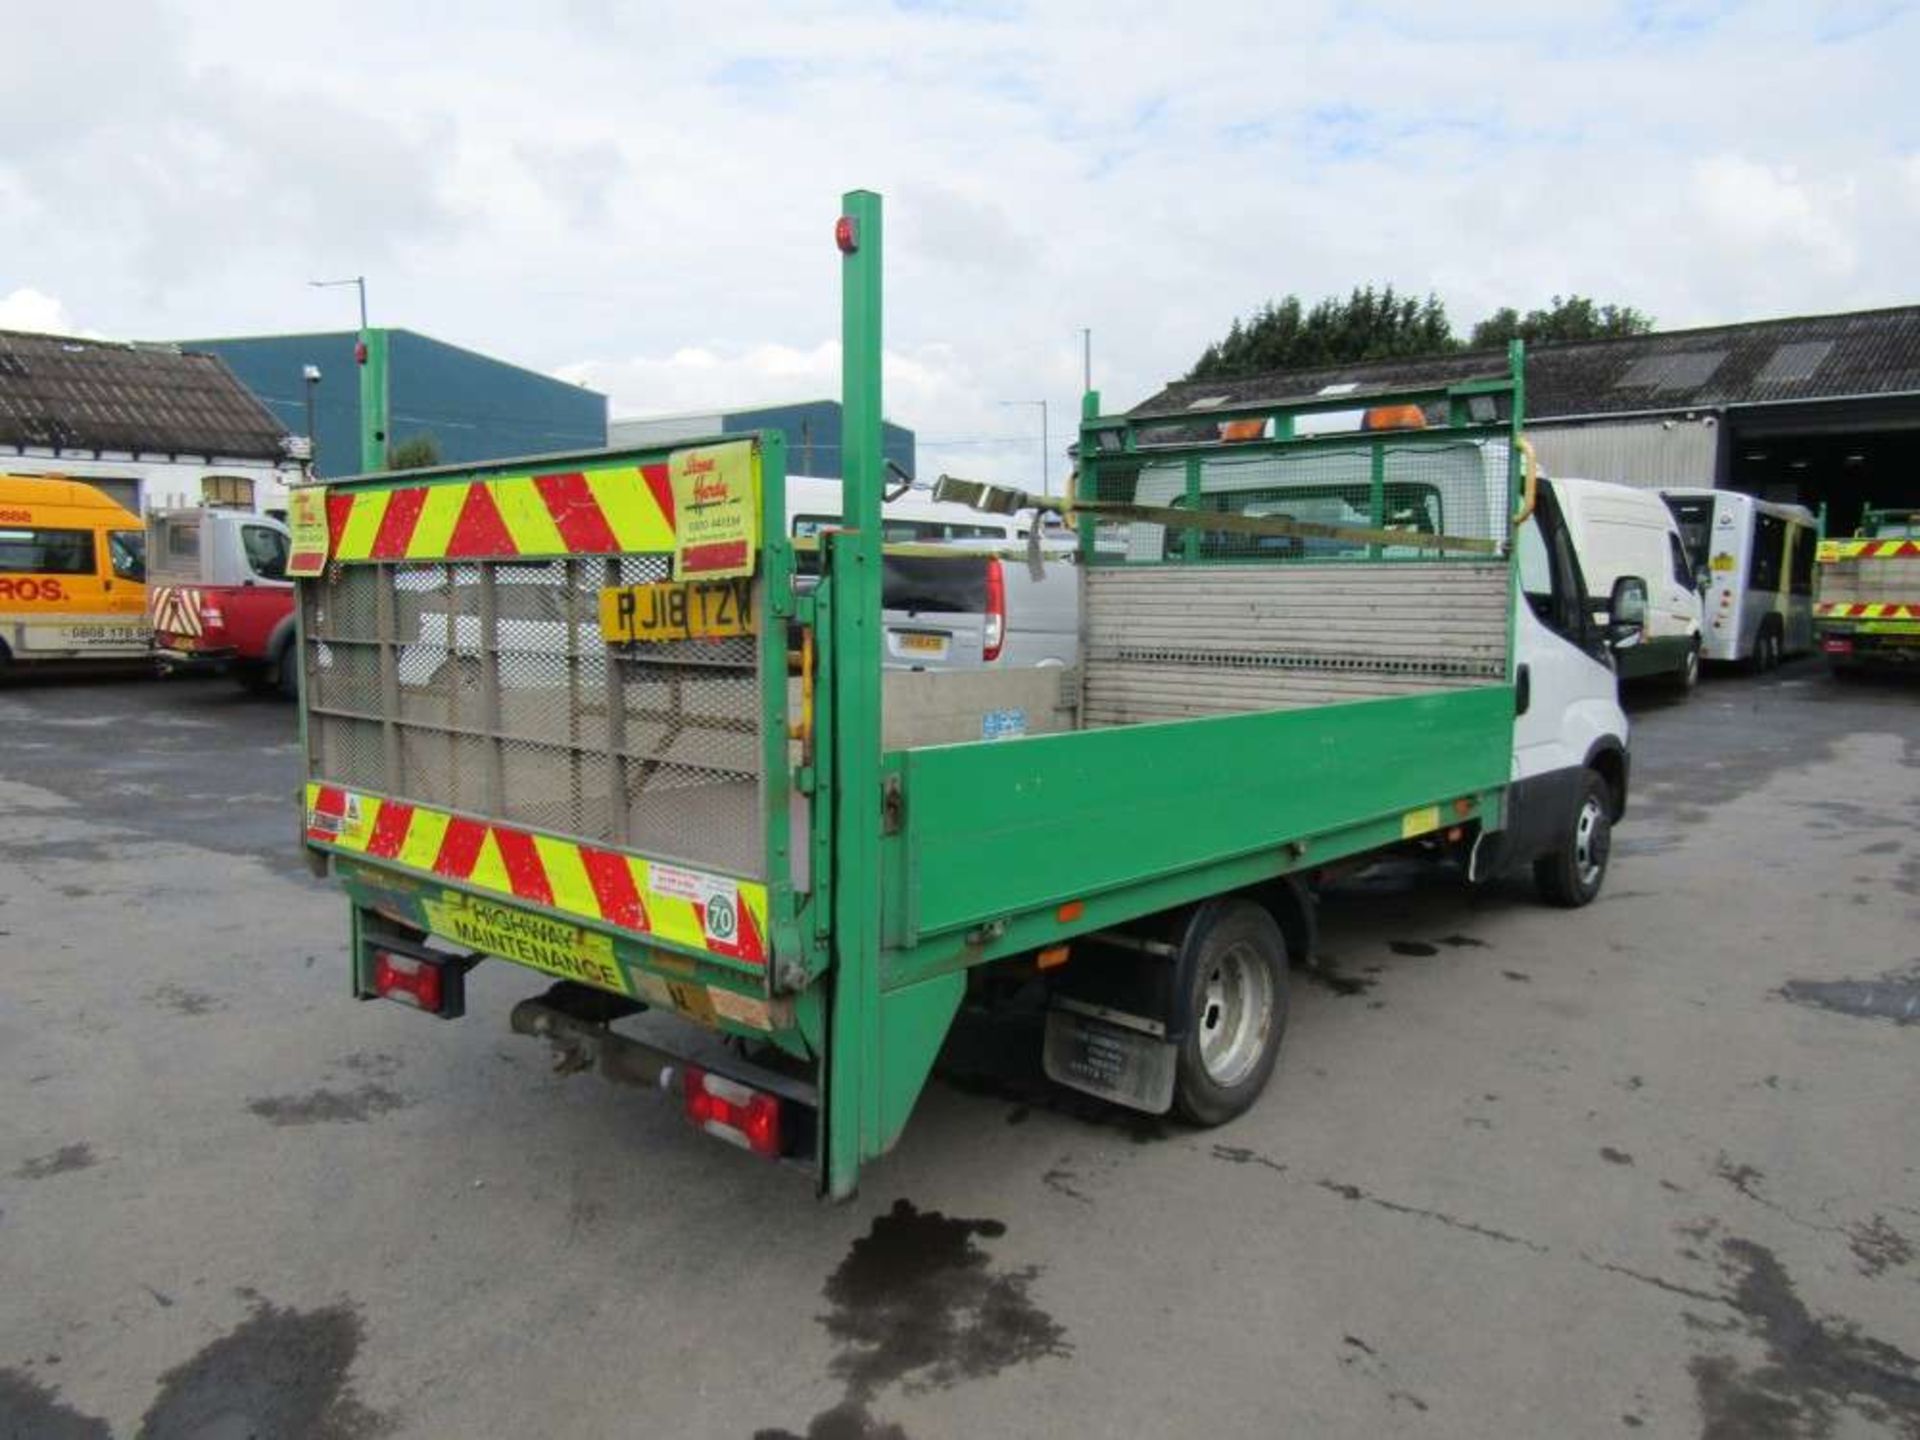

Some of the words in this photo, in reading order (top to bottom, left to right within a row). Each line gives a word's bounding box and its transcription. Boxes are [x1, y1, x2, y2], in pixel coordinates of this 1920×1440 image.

[617, 588, 684, 631] PJ18
[472, 902, 574, 949] HIGHWAY
[710, 904, 733, 932] 70
[454, 919, 620, 987] MAINTENANCE
